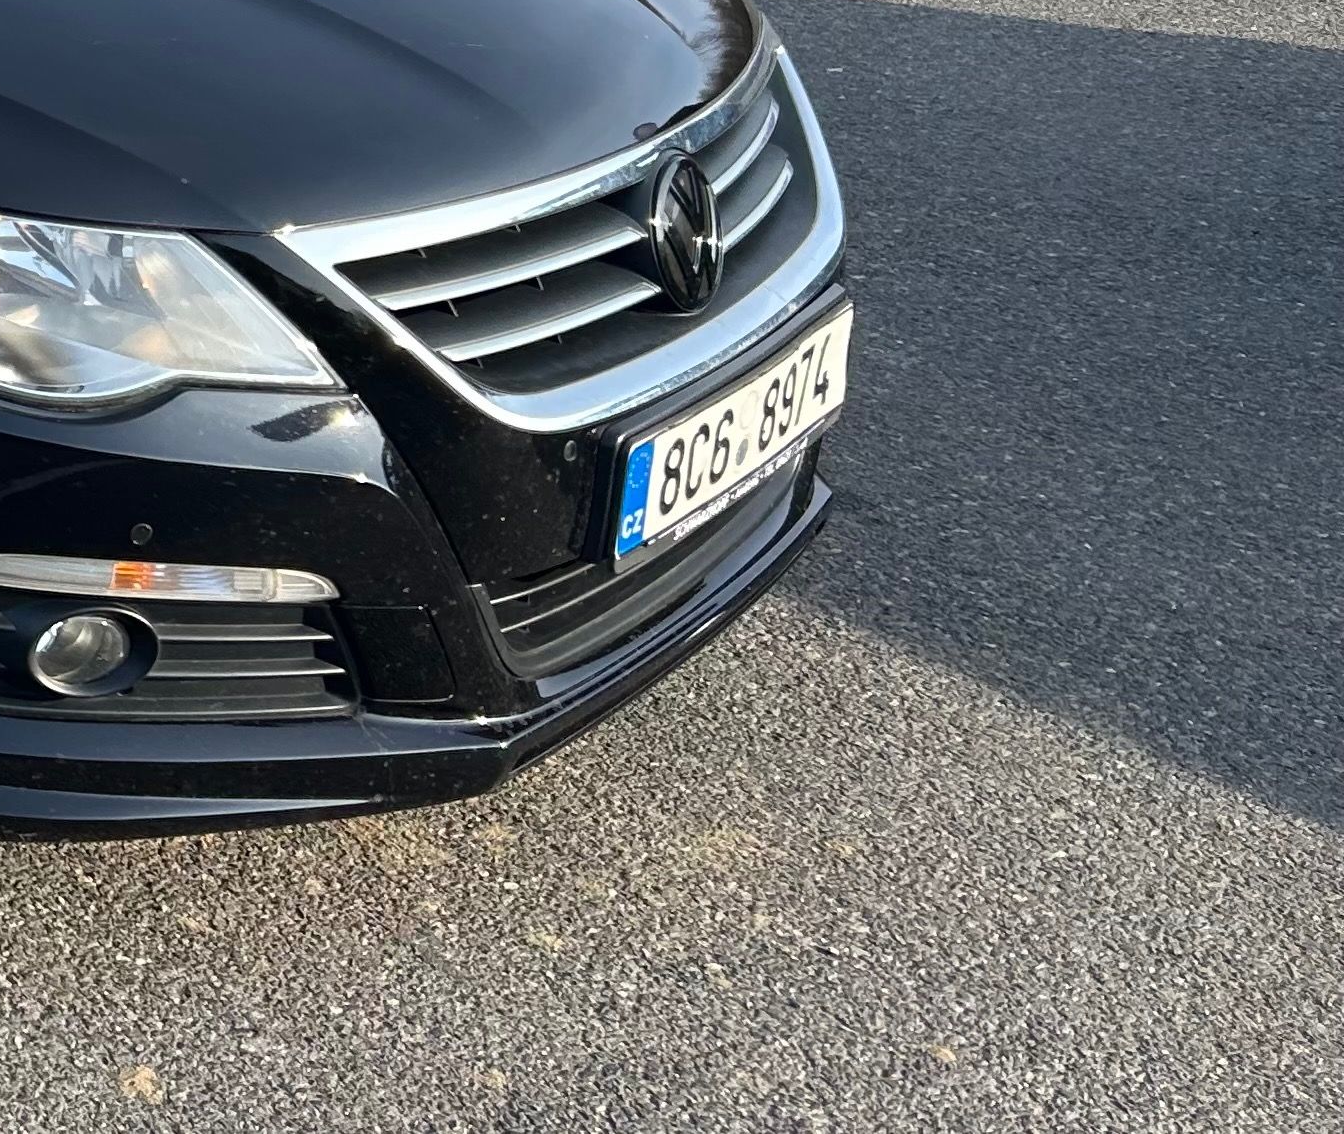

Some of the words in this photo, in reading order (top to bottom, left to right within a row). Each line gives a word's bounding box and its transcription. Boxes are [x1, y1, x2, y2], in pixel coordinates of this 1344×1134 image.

[659, 408, 735, 517] 8C6
[758, 332, 832, 453] 8974
[621, 508, 644, 539] CZ
